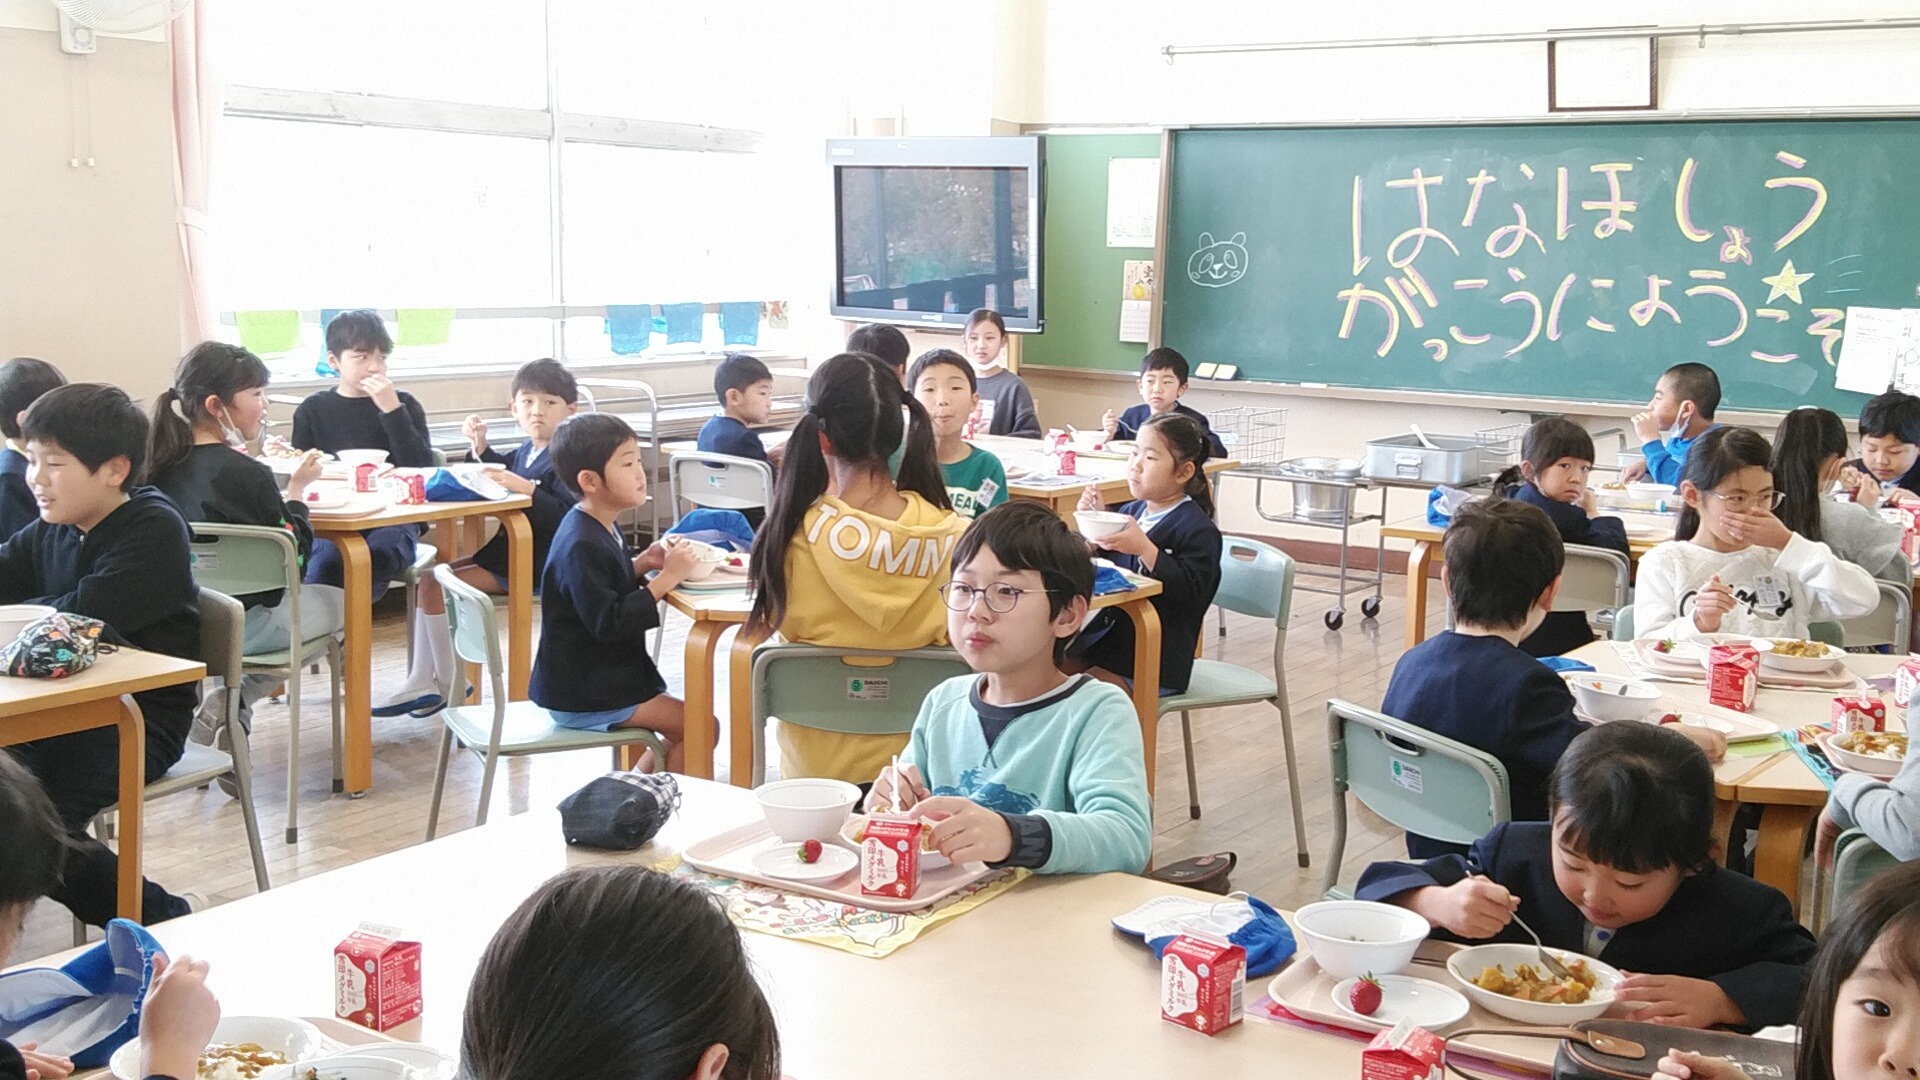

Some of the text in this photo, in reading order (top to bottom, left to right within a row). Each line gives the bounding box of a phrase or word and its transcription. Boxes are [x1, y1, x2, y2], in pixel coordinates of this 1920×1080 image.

[1352, 151, 1828, 276] はなほしょう
[1337, 265, 1845, 367] がっこうにようこそ
